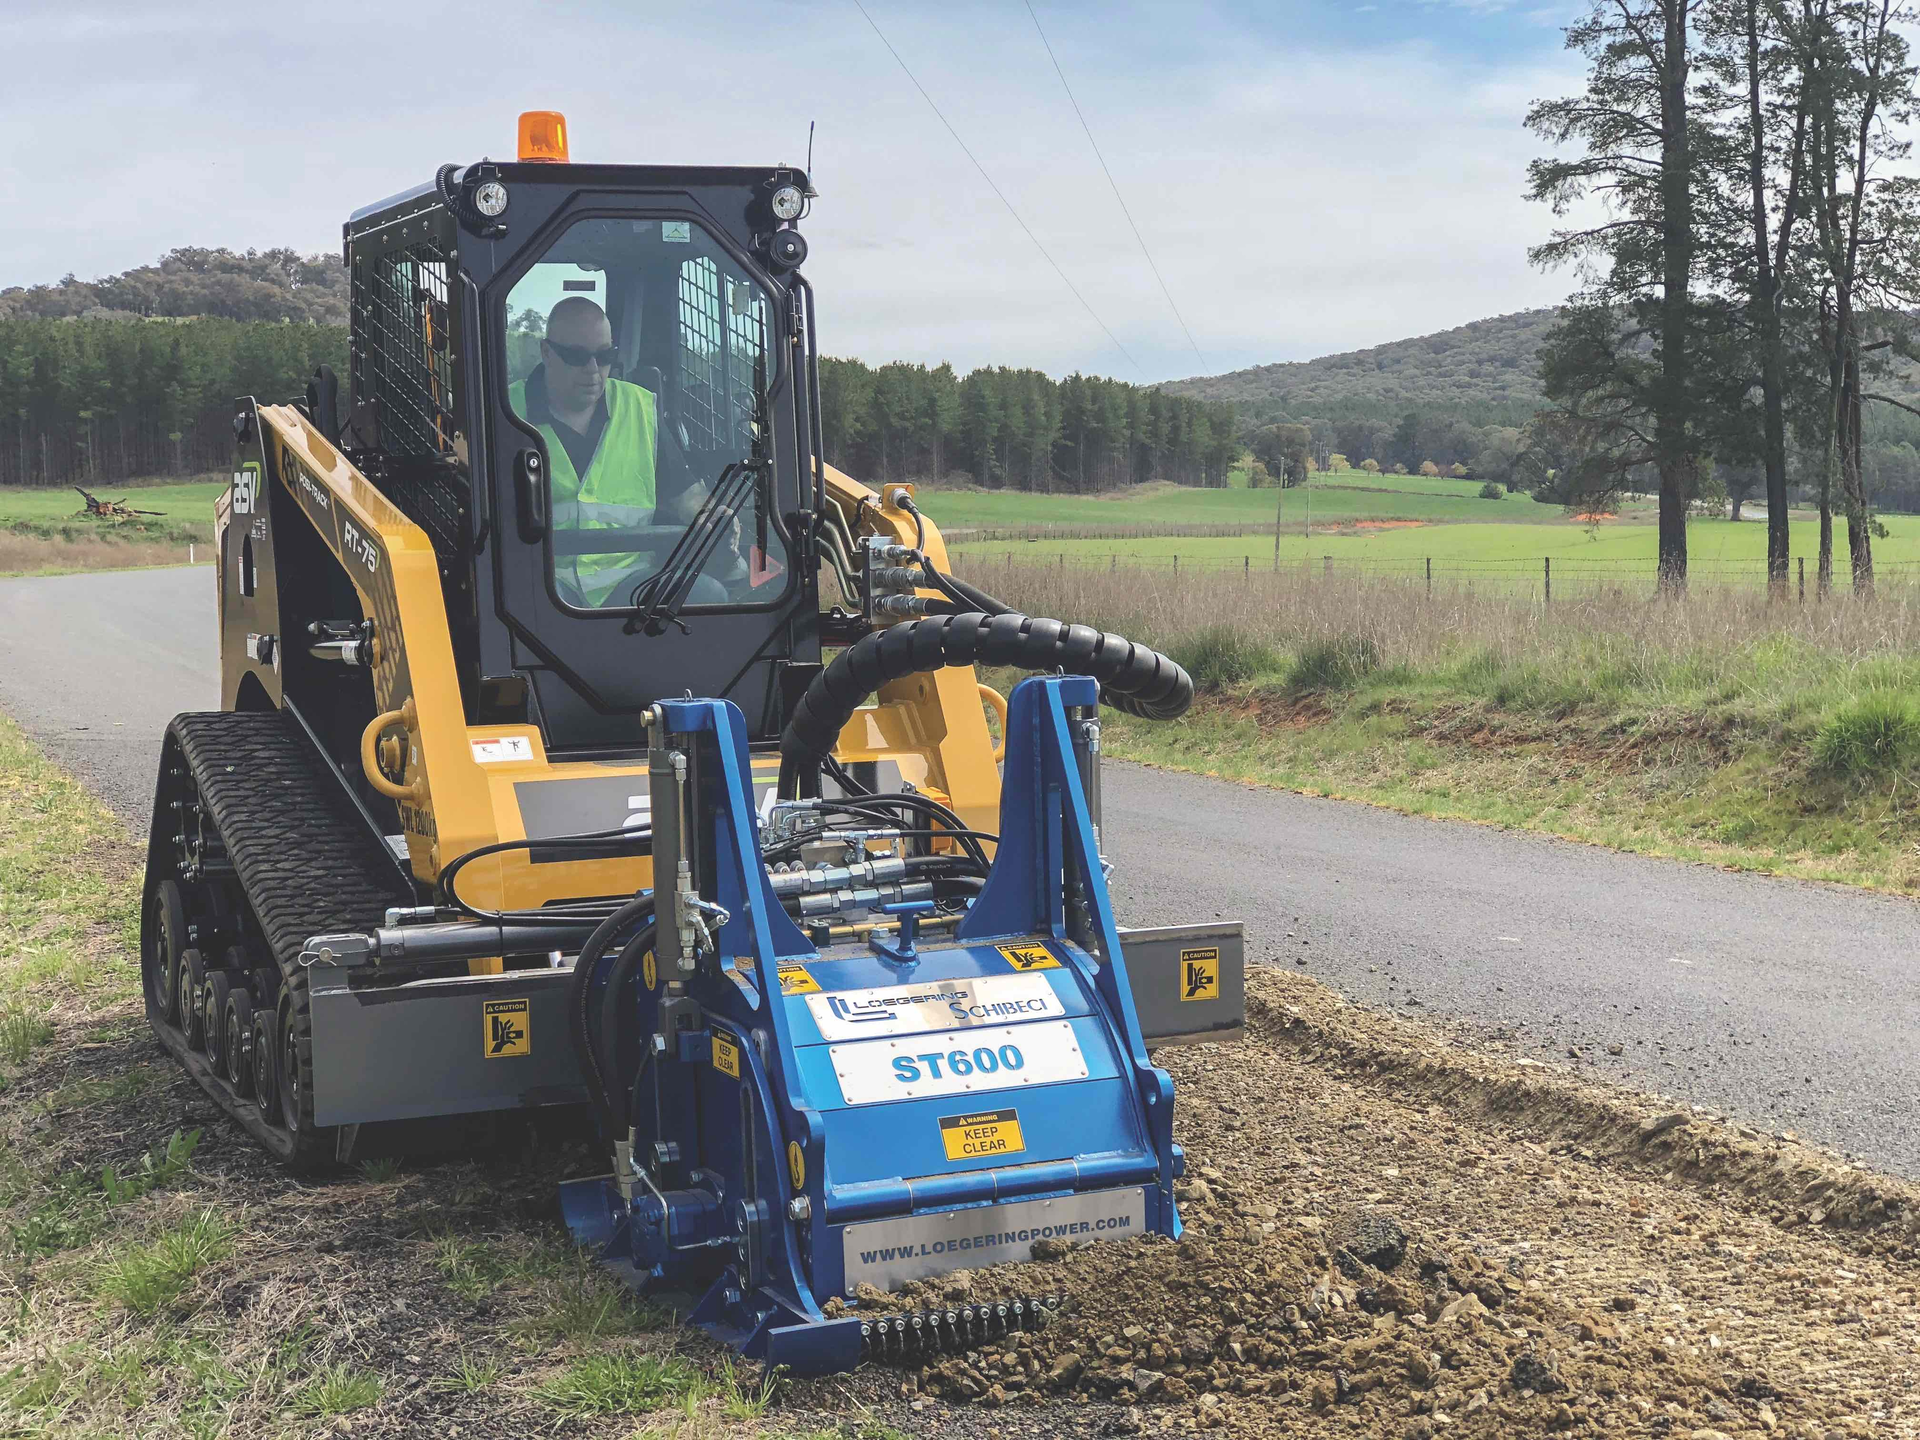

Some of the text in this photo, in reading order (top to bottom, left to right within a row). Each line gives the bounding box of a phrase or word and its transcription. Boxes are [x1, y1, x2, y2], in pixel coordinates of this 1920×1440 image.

[300, 472, 328, 510] POSI-TRACK
[344, 521, 376, 573] RT-75
[1189, 951, 1215, 959] CAUTION
[494, 1003, 525, 1011] CAUTION
[853, 991, 969, 1009] LOEGERING
[720, 1044, 732, 1056] KEEP
[718, 1056, 734, 1073] CLEAR
[892, 1044, 1025, 1083] ST600
[966, 1114, 998, 1123] WARNING
[964, 1126, 998, 1140] KEEP
[963, 1139, 1007, 1154] CLEAR
[860, 1215, 1131, 1265] WWW.LOEGERINGPOWER.COM
